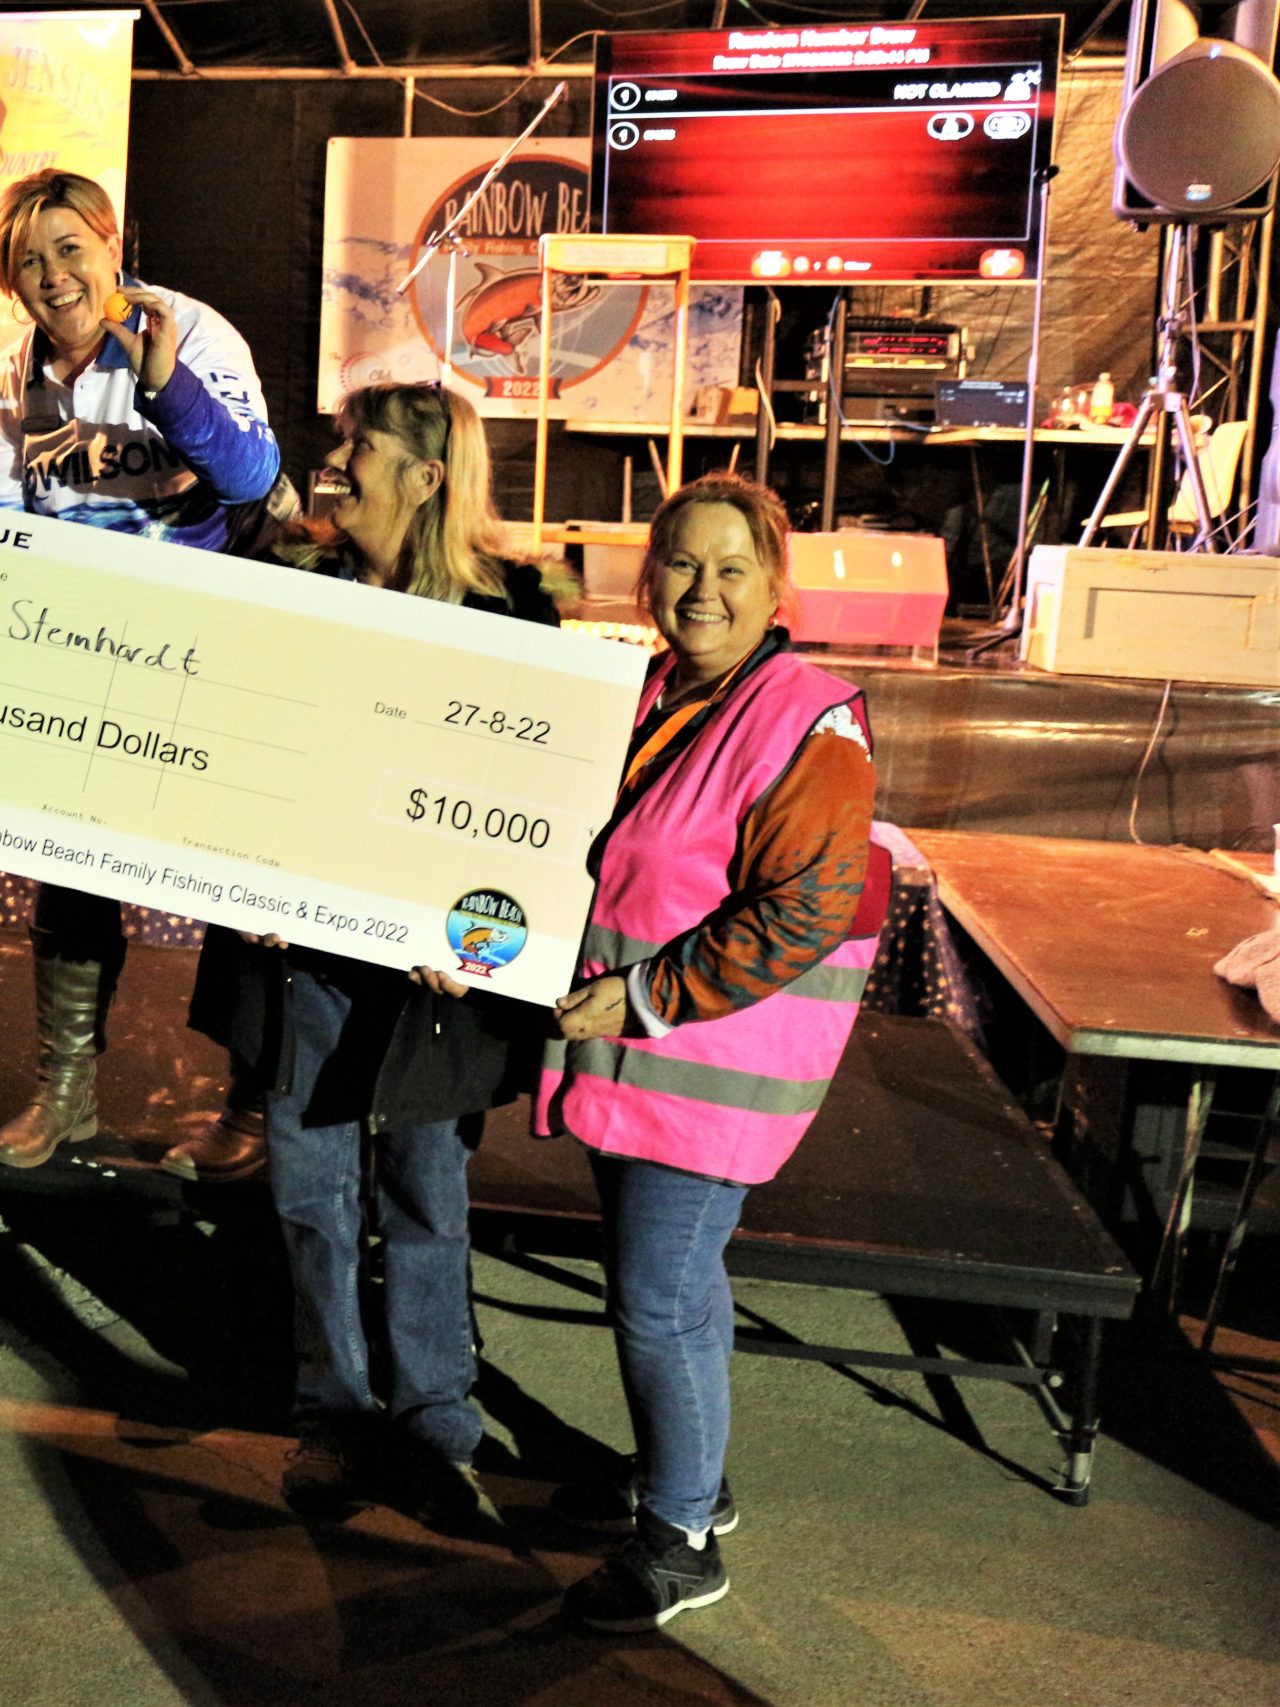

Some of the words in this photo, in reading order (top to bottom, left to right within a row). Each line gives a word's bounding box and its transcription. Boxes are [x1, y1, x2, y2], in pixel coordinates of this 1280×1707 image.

[729, 32, 799, 49] Random
[800, 29, 869, 47] Number
[870, 27, 916, 45] Draw
[894, 83, 929, 100] NOT
[929, 81, 1001, 99] CLAIMED
[445, 180, 548, 237] RAINBOW
[502, 381, 541, 397] 2022
[374, 701, 408, 720] Date
[444, 700, 551, 745] 27-8-22
[96, 720, 210, 773] Dollars
[41, 804, 84, 820] Account
[406, 787, 551, 849] $10,000
[181, 836, 250, 861] Transaction
[255, 854, 282, 868] Code
[41, 839, 95, 867] Beach
[99, 853, 157, 885] Family
[161, 868, 224, 903] Fishing
[228, 884, 291, 915] Classic
[296, 901, 308, 920] &
[314, 905, 359, 932] Expo
[363, 917, 409, 944] 2022
